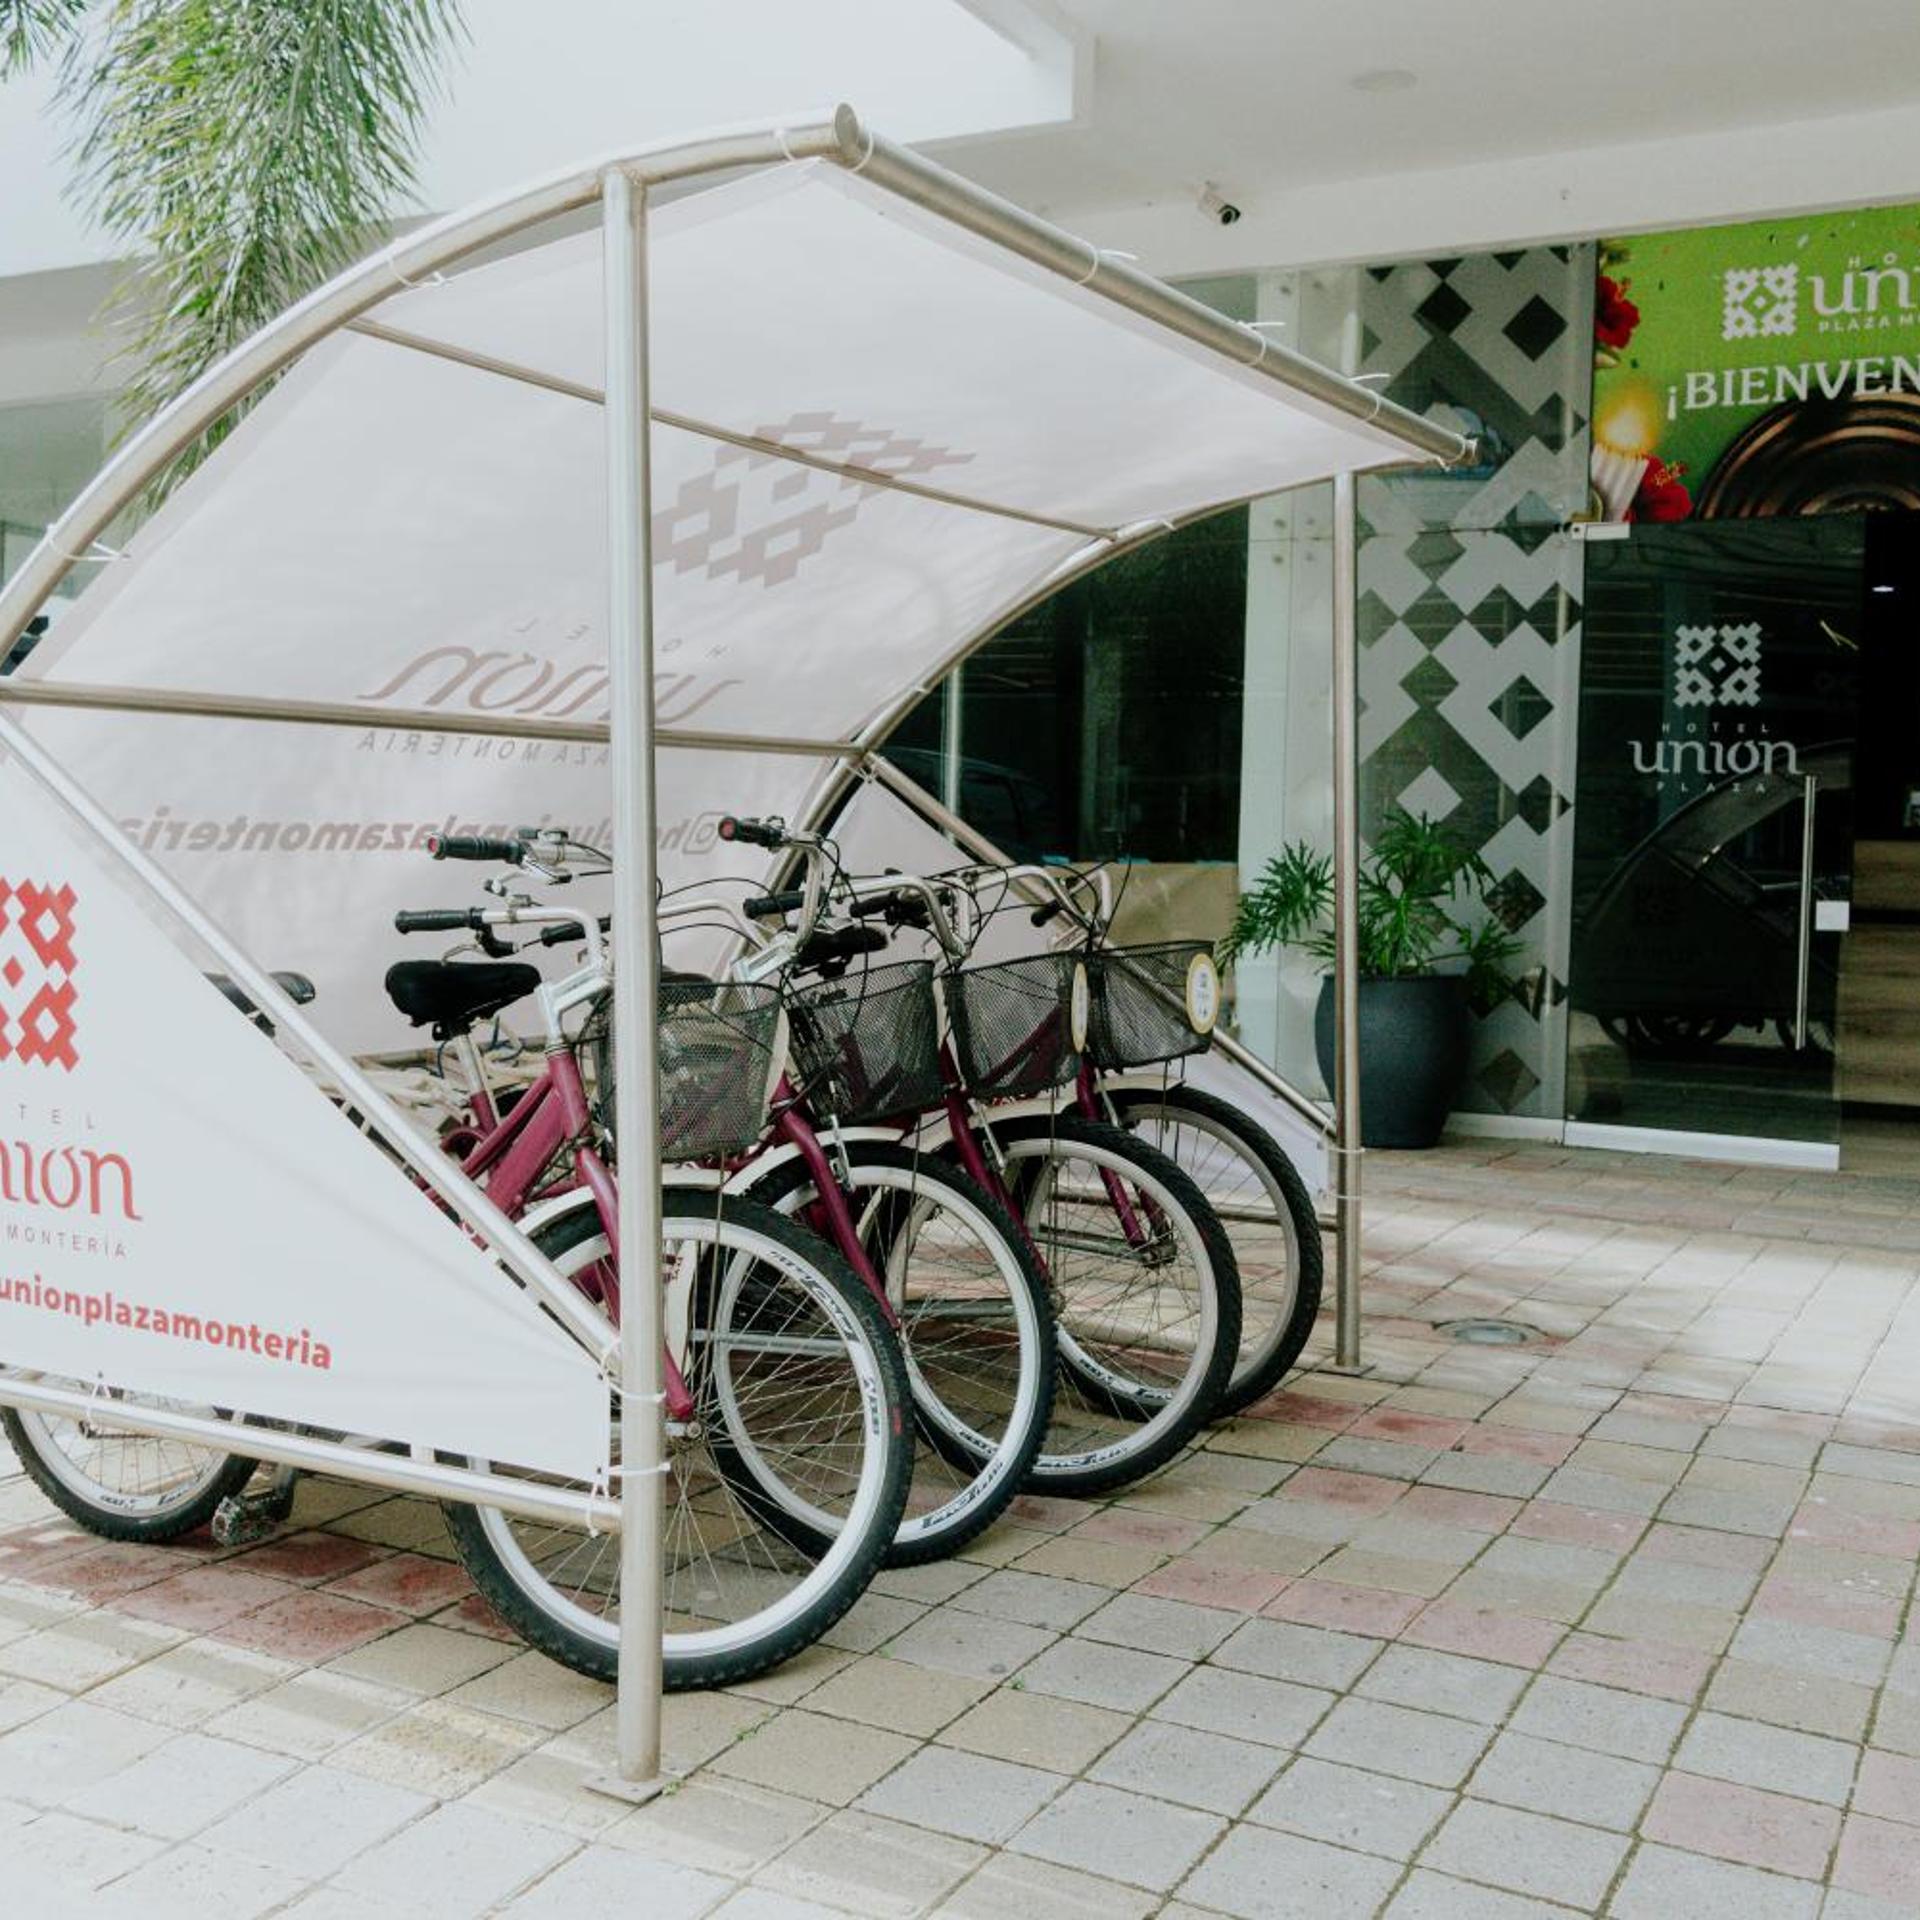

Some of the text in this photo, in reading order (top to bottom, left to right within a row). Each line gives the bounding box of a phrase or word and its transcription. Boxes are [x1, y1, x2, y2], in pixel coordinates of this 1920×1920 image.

[1806, 267, 1920, 316] un
[1819, 316, 1890, 334] PLAZA
[1661, 722, 1769, 733] HOTEL
[1656, 781, 1766, 793] PLAZA
